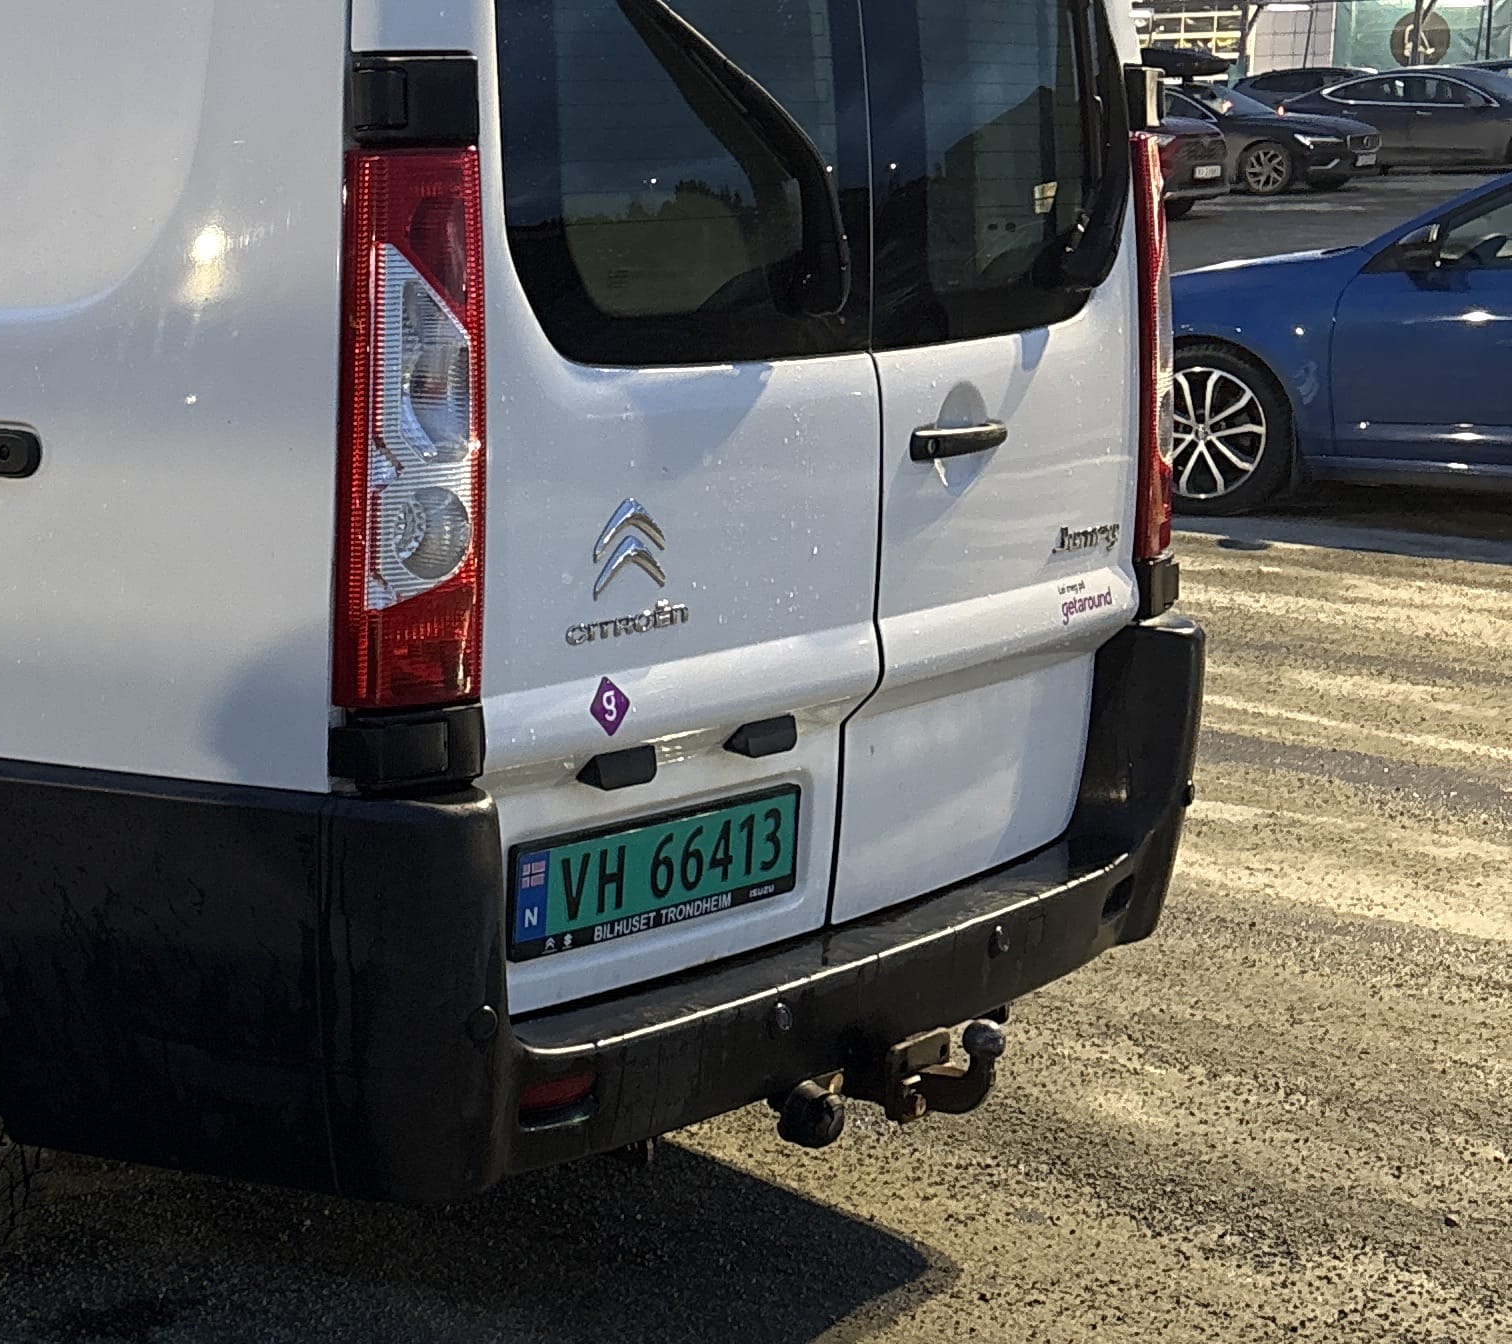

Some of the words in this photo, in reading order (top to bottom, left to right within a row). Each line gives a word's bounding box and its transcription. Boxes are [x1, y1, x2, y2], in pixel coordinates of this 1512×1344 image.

[1061, 586, 1113, 625] getaround
[561, 845, 626, 922] VH
[650, 807, 783, 899] 66413
[748, 884, 775, 899] ISUZU
[523, 906, 539, 928] N
[593, 911, 657, 942] BILHUSET
[661, 892, 733, 925] TRONDHEIM
